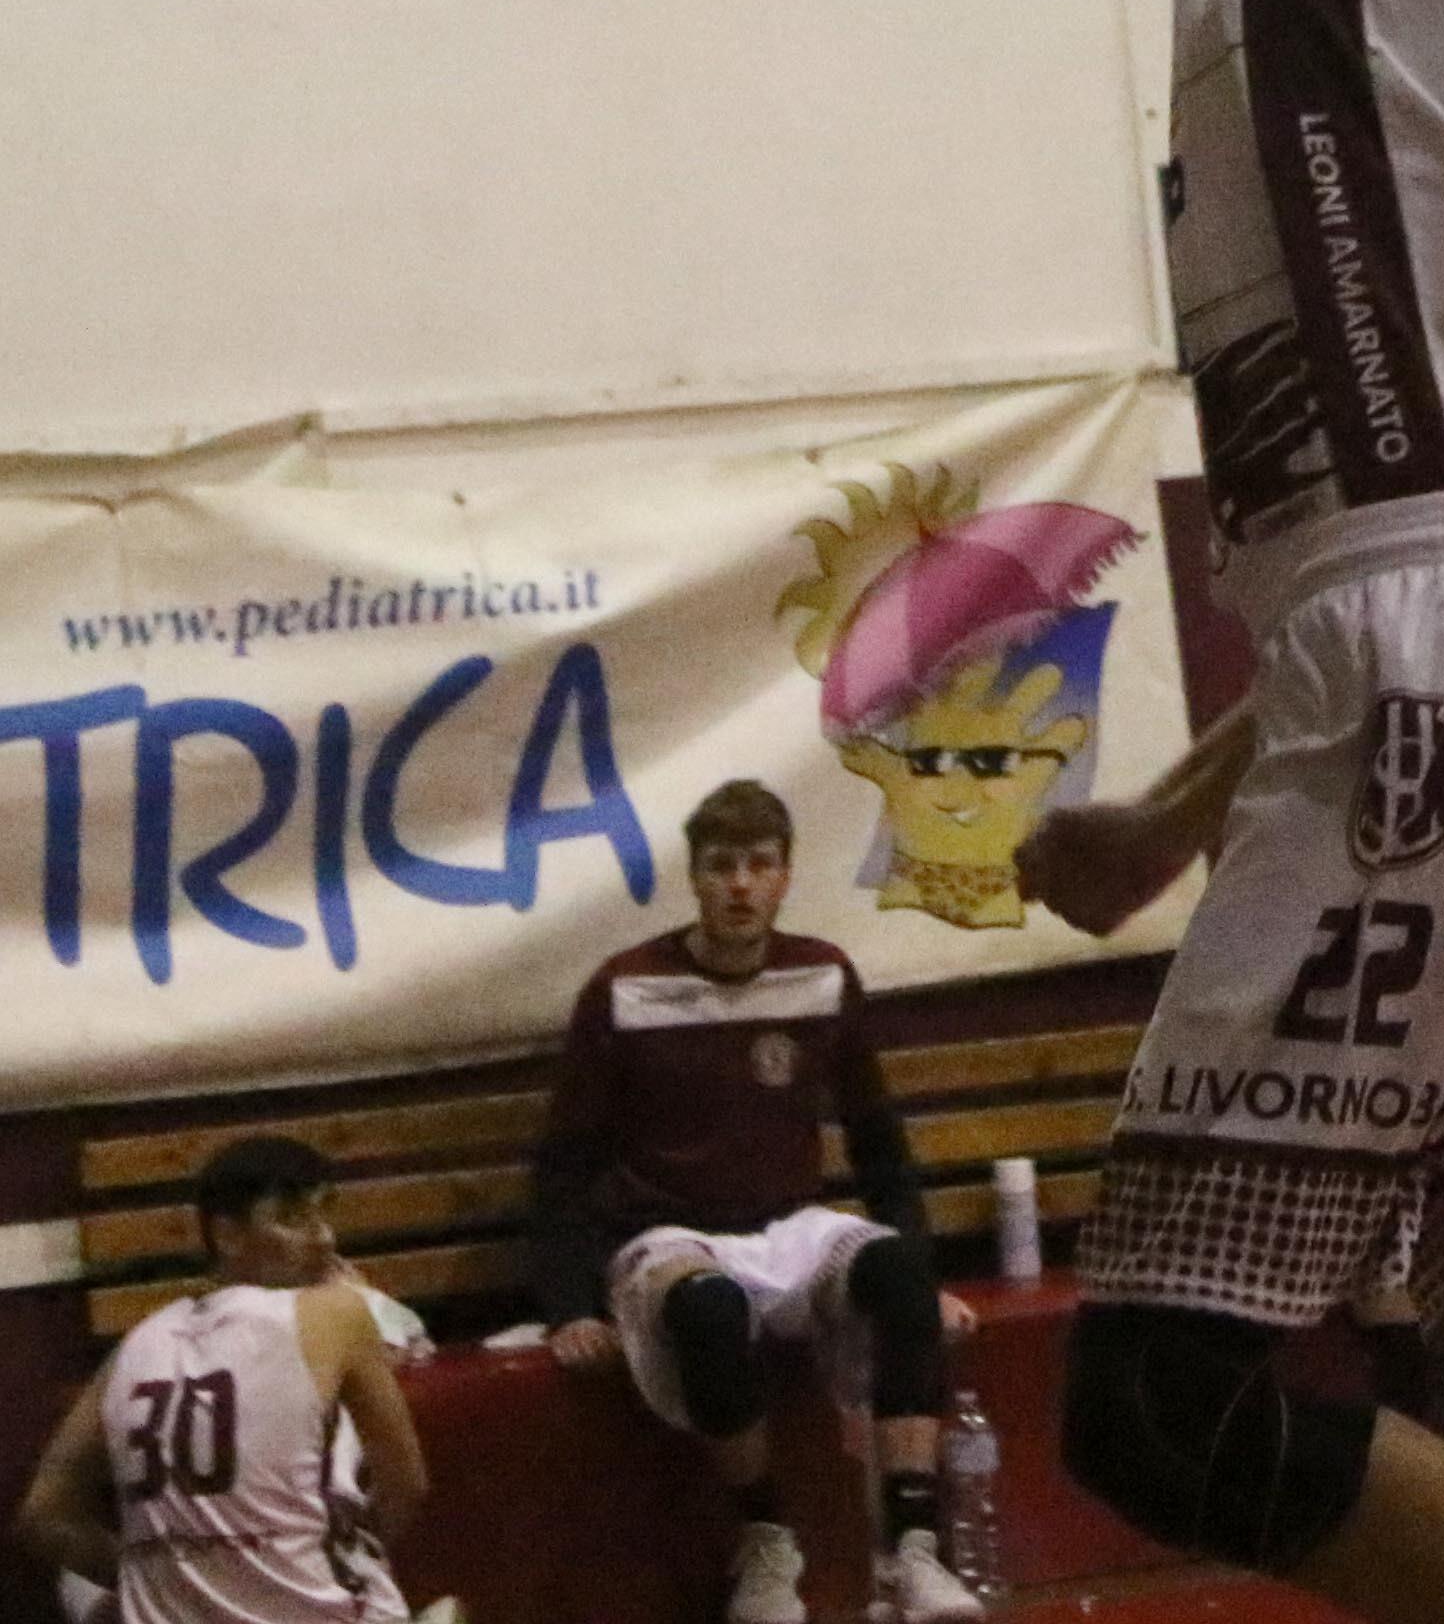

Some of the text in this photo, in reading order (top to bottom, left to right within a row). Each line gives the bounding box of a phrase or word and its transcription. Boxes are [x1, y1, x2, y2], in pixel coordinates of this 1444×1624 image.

[1299, 113, 1411, 465] LEONI AMARNATO
[61, 570, 603, 657] www.pediatrica.it
[1272, 899, 1436, 1049] 22
[1159, 1066, 1412, 1129] LIVORNO
